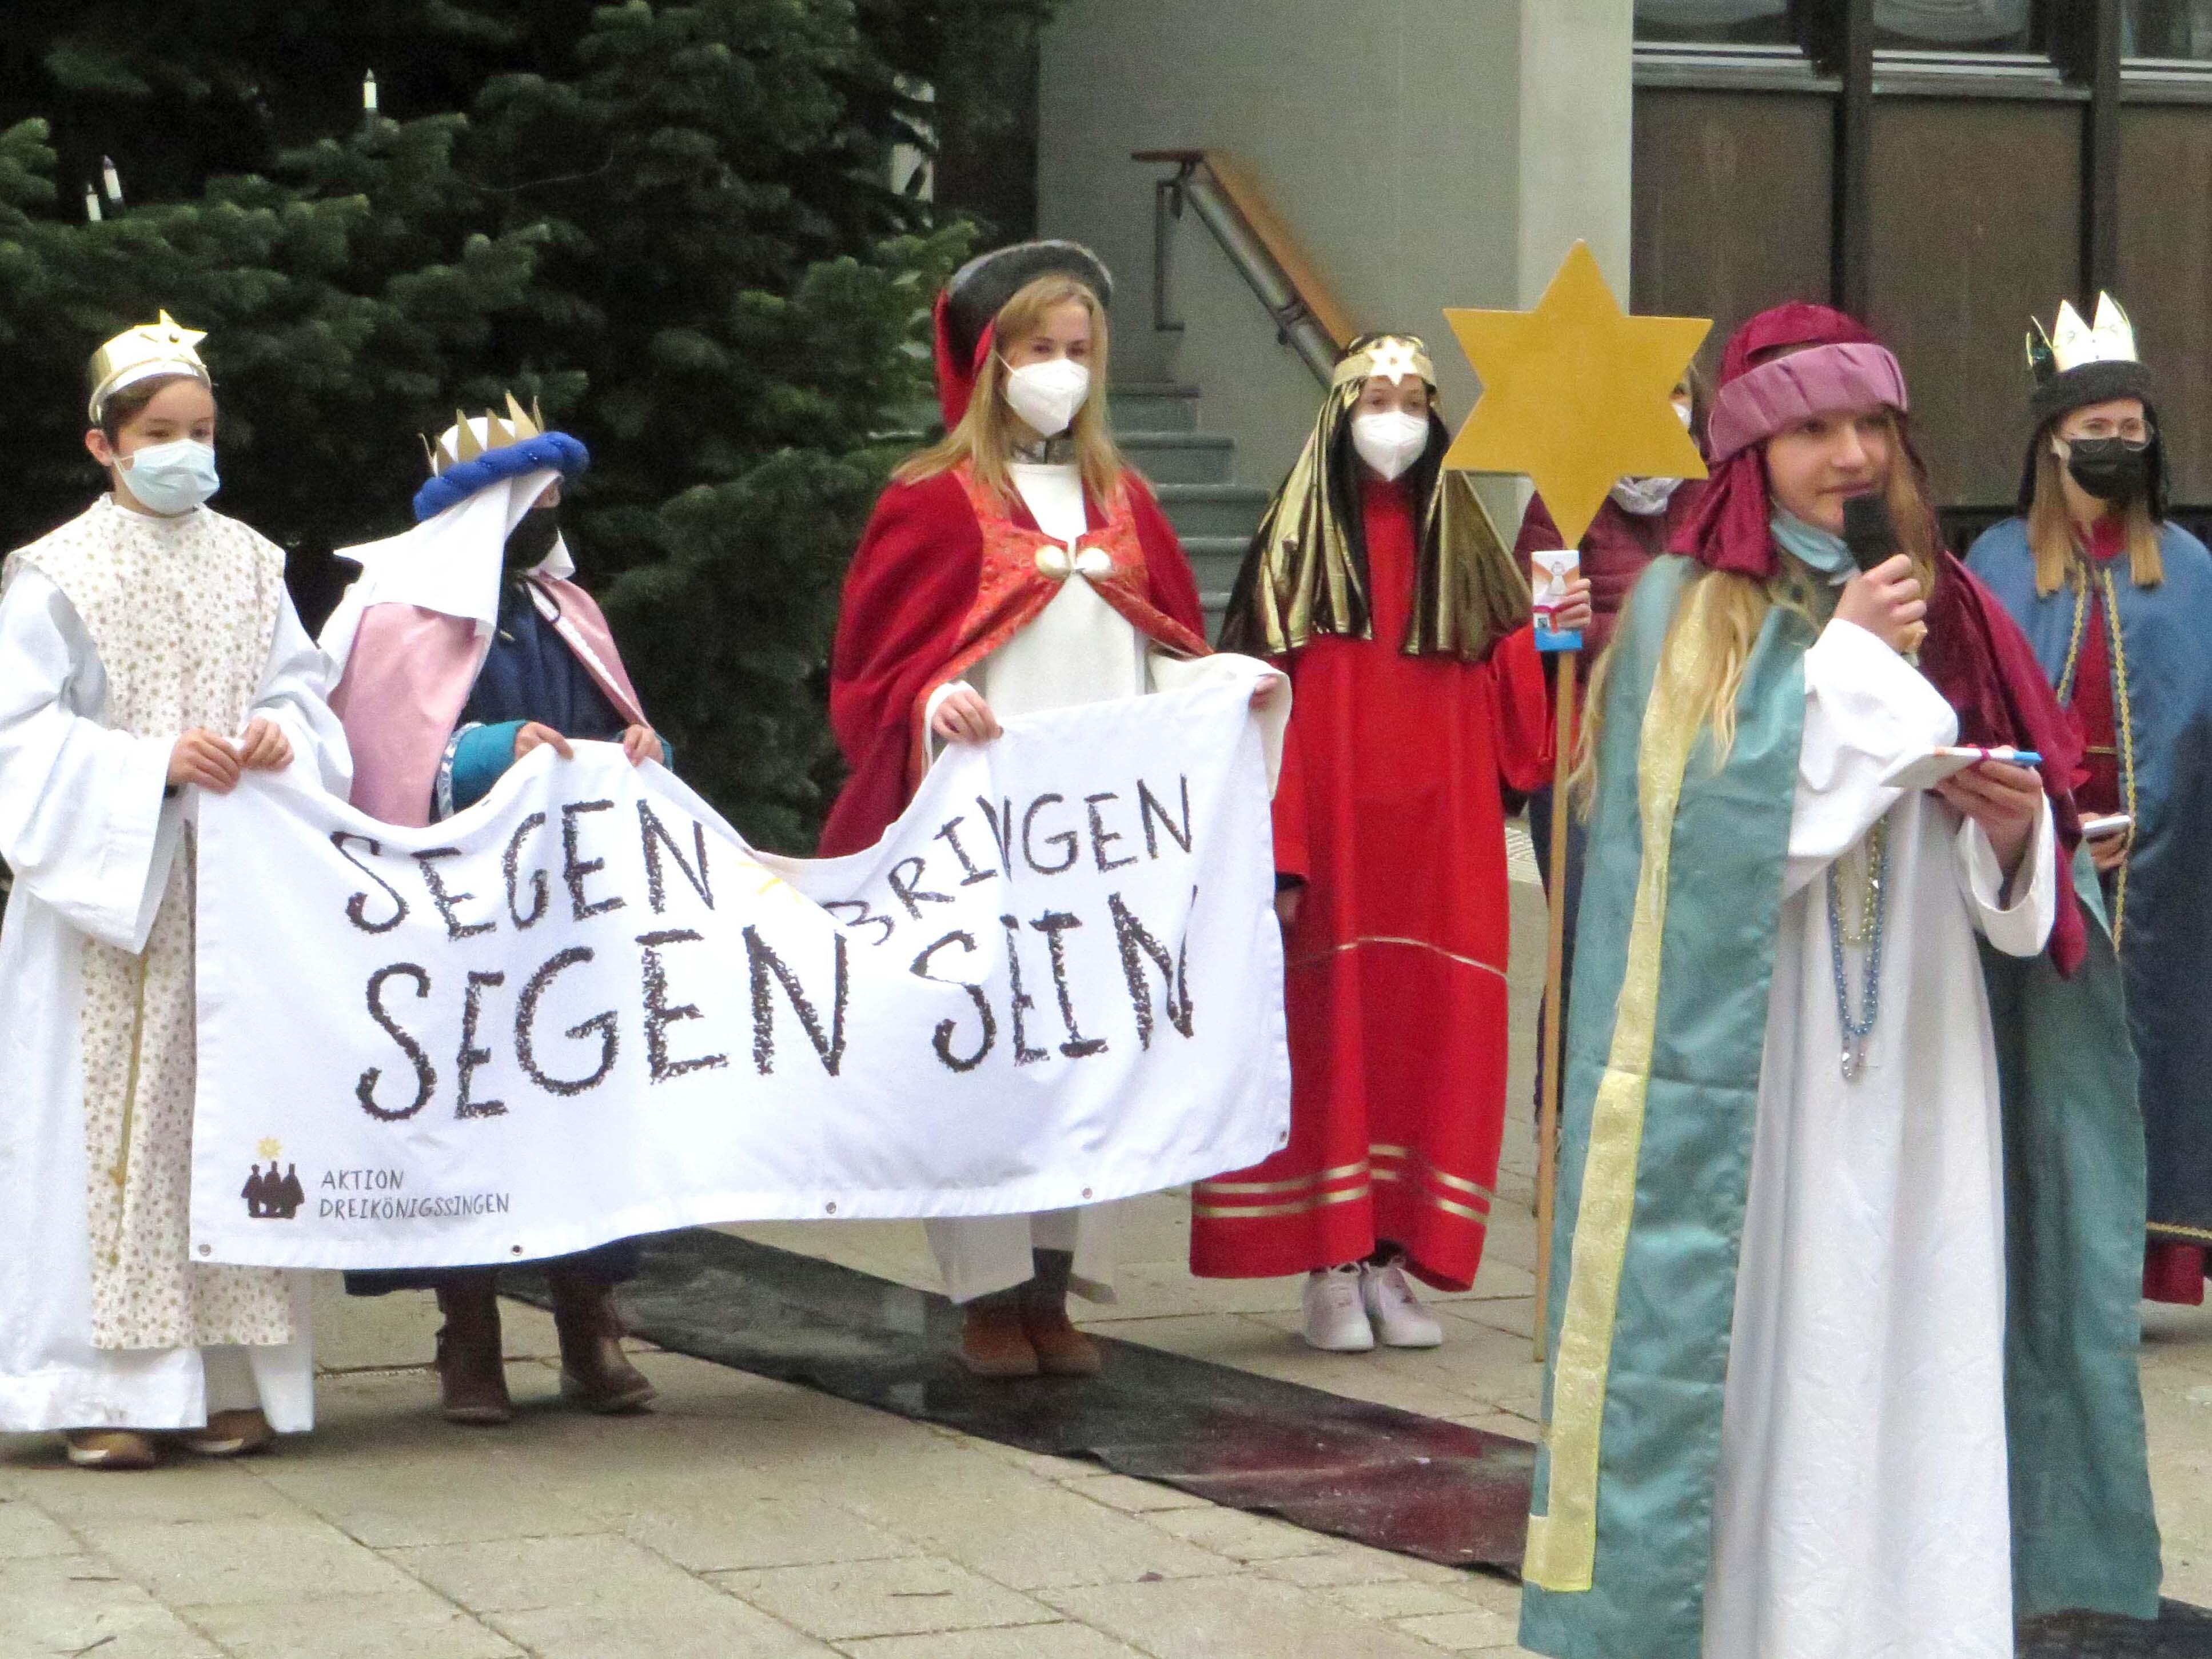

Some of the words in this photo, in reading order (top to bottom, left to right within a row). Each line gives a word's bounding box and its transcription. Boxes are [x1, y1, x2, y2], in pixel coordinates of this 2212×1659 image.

[330, 799, 716, 942] SEGEN
[356, 924, 850, 1122] SEGEN
[909, 884, 1198, 1073] SEIN
[318, 1193, 510, 1220] DREIKÖNIGSSINGEN
[320, 1169, 404, 1191] AKTION
